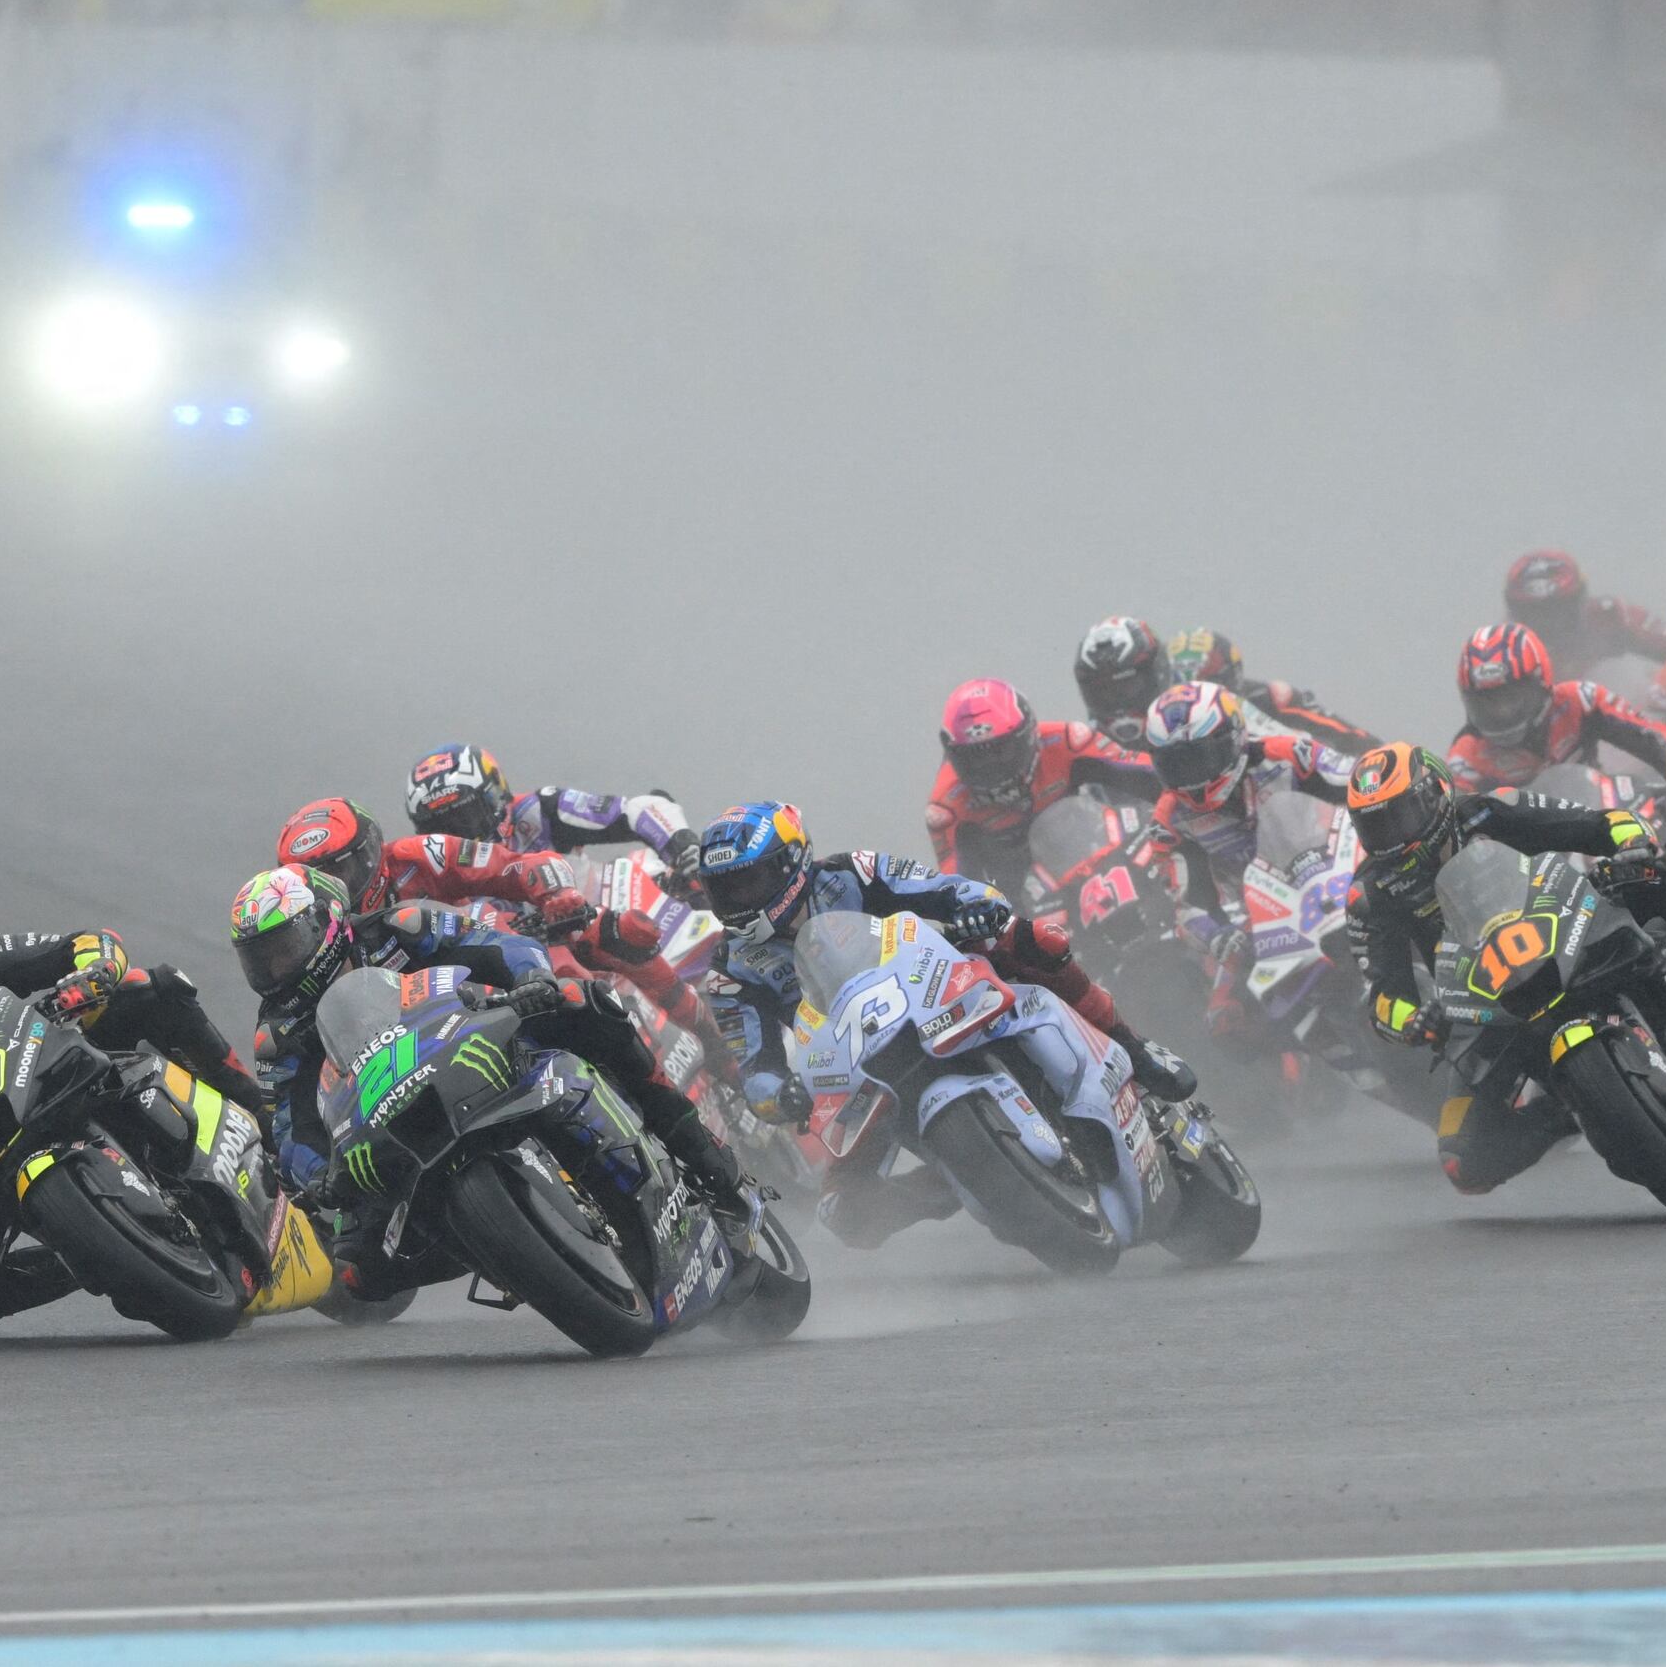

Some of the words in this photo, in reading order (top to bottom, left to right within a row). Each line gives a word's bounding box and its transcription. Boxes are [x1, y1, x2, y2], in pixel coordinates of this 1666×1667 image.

[421, 784, 460, 805] SHARK
[707, 849, 733, 864] SHOEI
[1079, 866, 1139, 930] 41
[1565, 894, 1595, 957] mooneygo
[313, 933, 344, 978] MONSTER
[908, 947, 935, 984] Unibat
[1254, 933, 1300, 957] prima
[1480, 921, 1545, 991] 10
[351, 1024, 408, 1076] ENEOS
[833, 972, 910, 1071] 73
[921, 1012, 952, 1035] BOLD
[15, 1022, 45, 1088] mooneygo
[356, 1028, 419, 1125] 21
[369, 1063, 438, 1129] MONSTER
